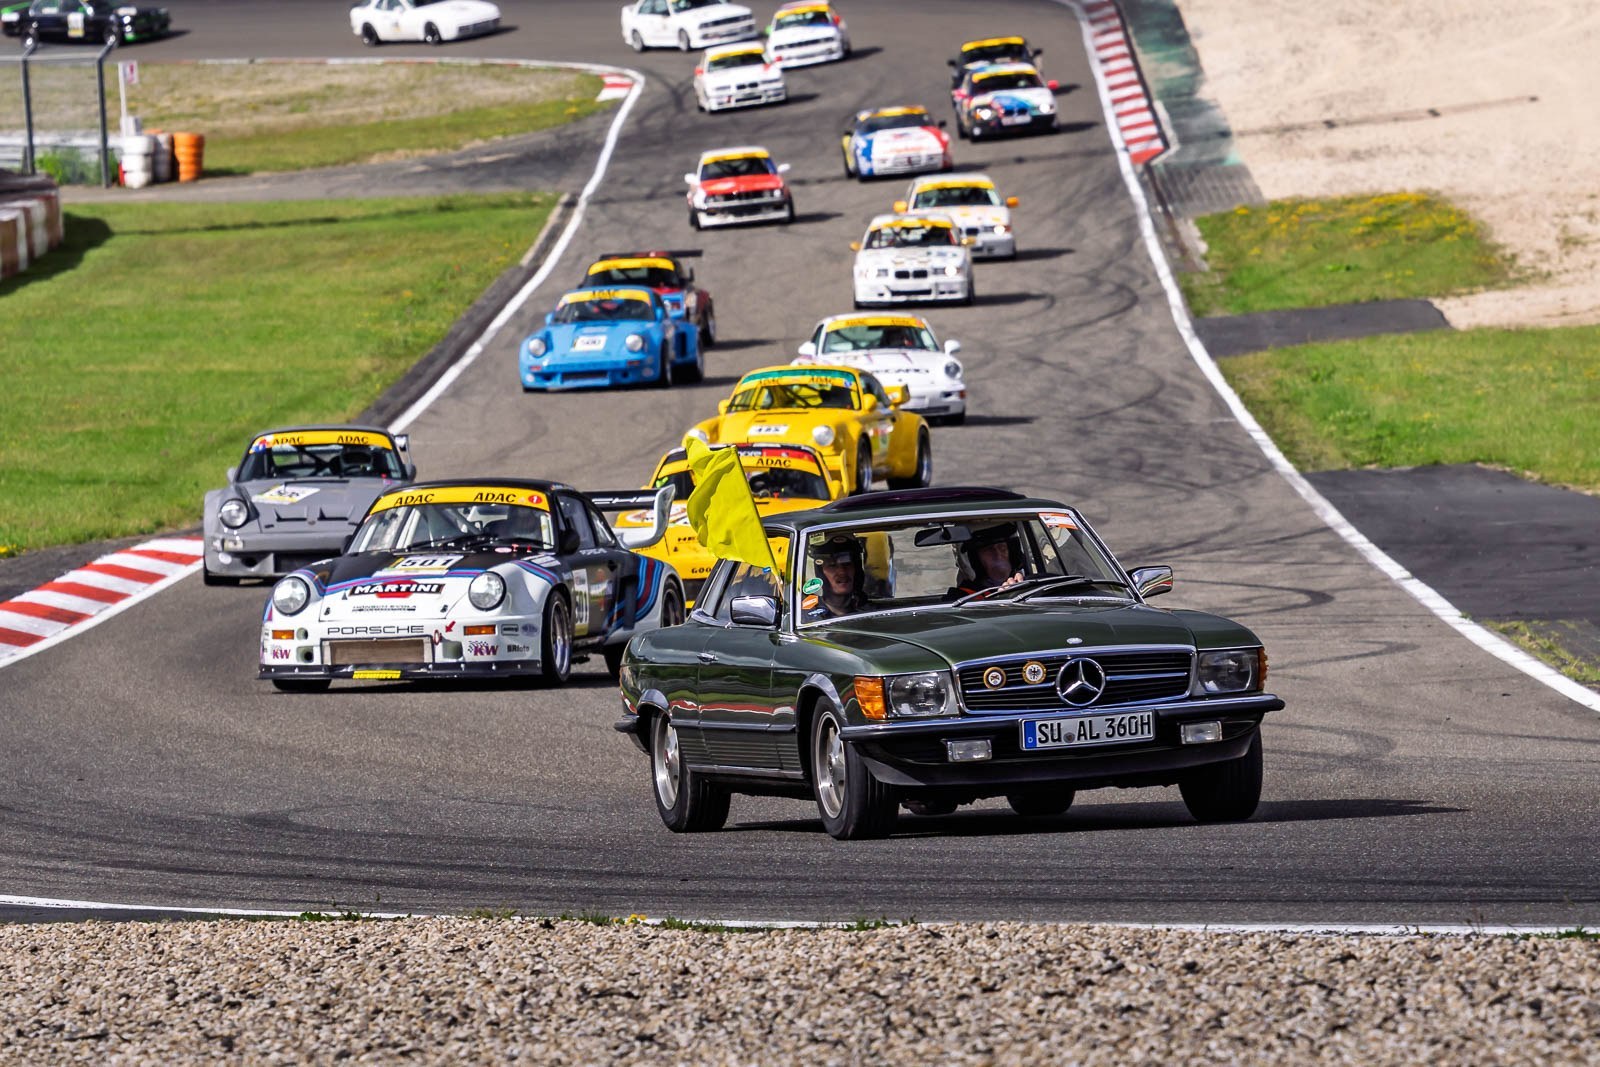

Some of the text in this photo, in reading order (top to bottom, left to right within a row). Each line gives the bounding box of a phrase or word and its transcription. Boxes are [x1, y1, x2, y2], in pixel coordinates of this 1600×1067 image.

[273, 434, 369, 446] ADAC ADAC
[755, 457, 792, 468] ADAC
[393, 493, 435, 506] ADAC
[473, 491, 517, 504] ADAC
[400, 557, 456, 568] 501
[354, 583, 441, 595] MARTINI
[327, 625, 425, 636] PORSCHE
[272, 648, 292, 660] KW
[473, 644, 499, 657] KW
[1037, 714, 1151, 745] SU AL 360H
